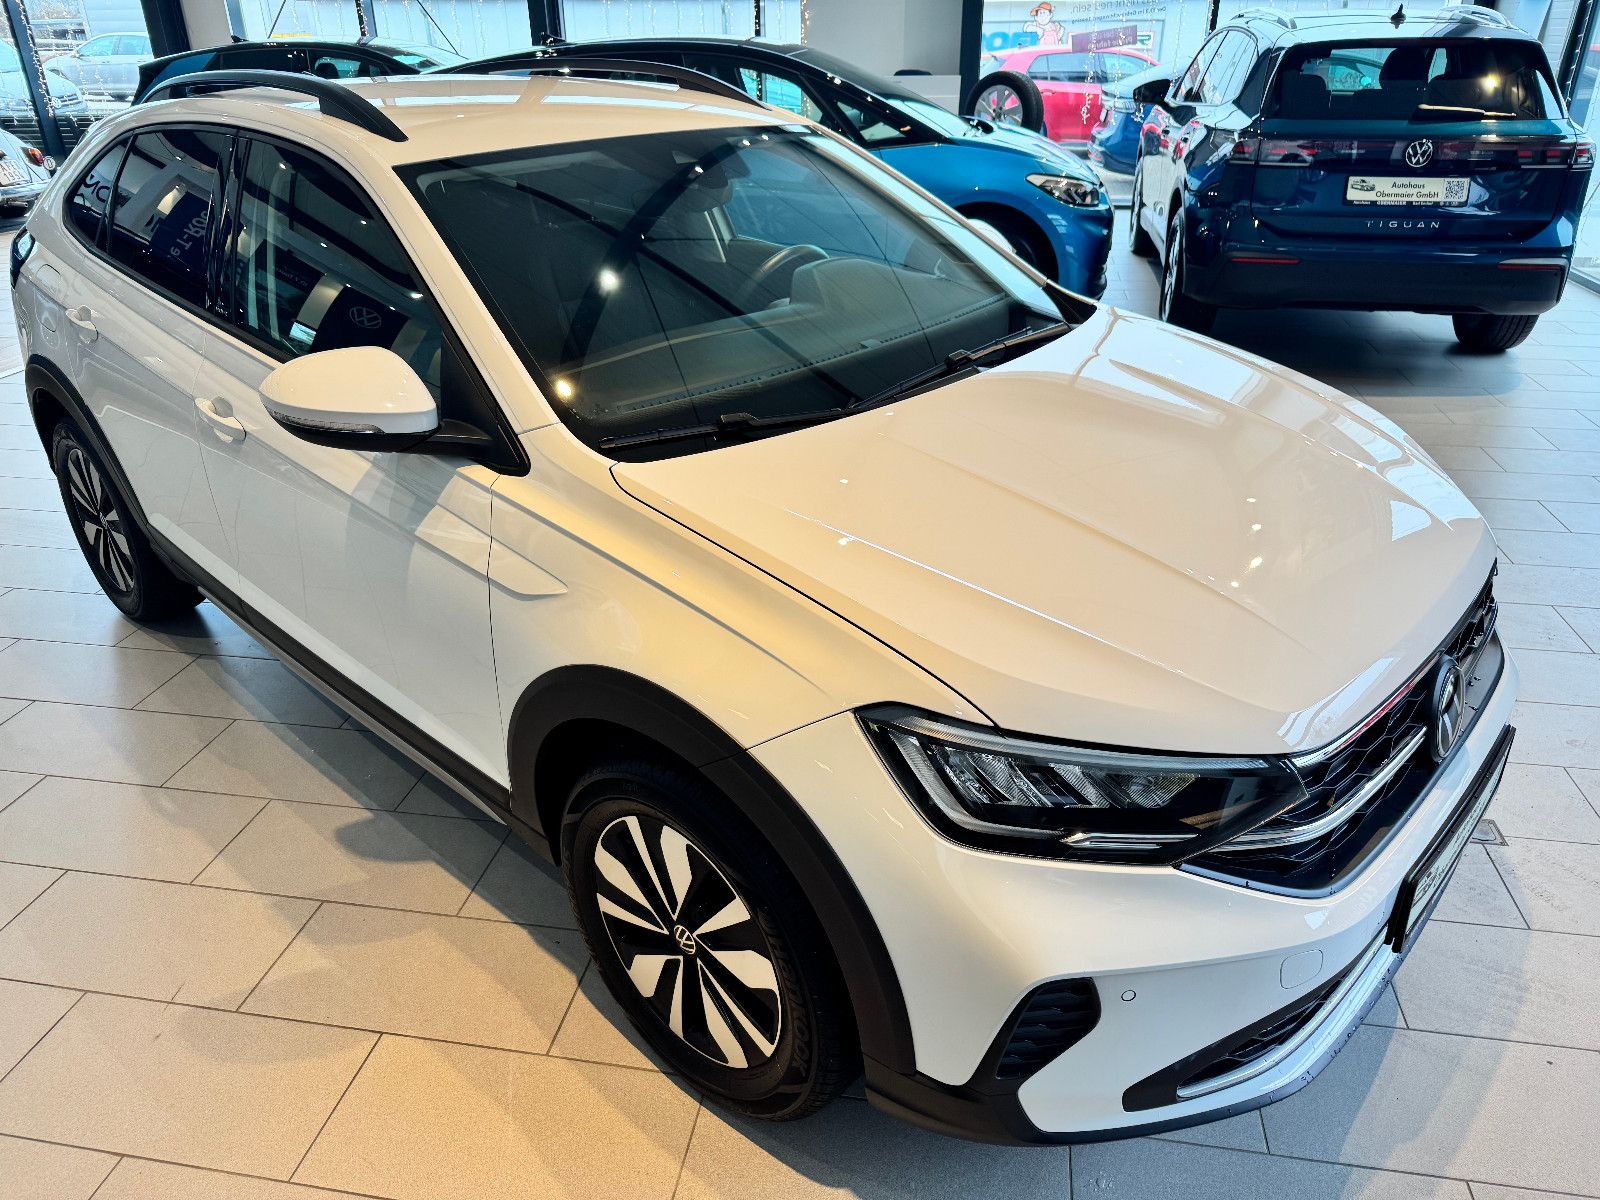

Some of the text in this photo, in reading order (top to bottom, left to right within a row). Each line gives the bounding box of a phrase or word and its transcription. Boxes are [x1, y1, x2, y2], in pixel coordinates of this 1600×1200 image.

[1391, 181, 1426, 189] Autohaus
[1375, 190, 1439, 199] Obermaier GmbH
[1365, 220, 1440, 229] TIGUAN
